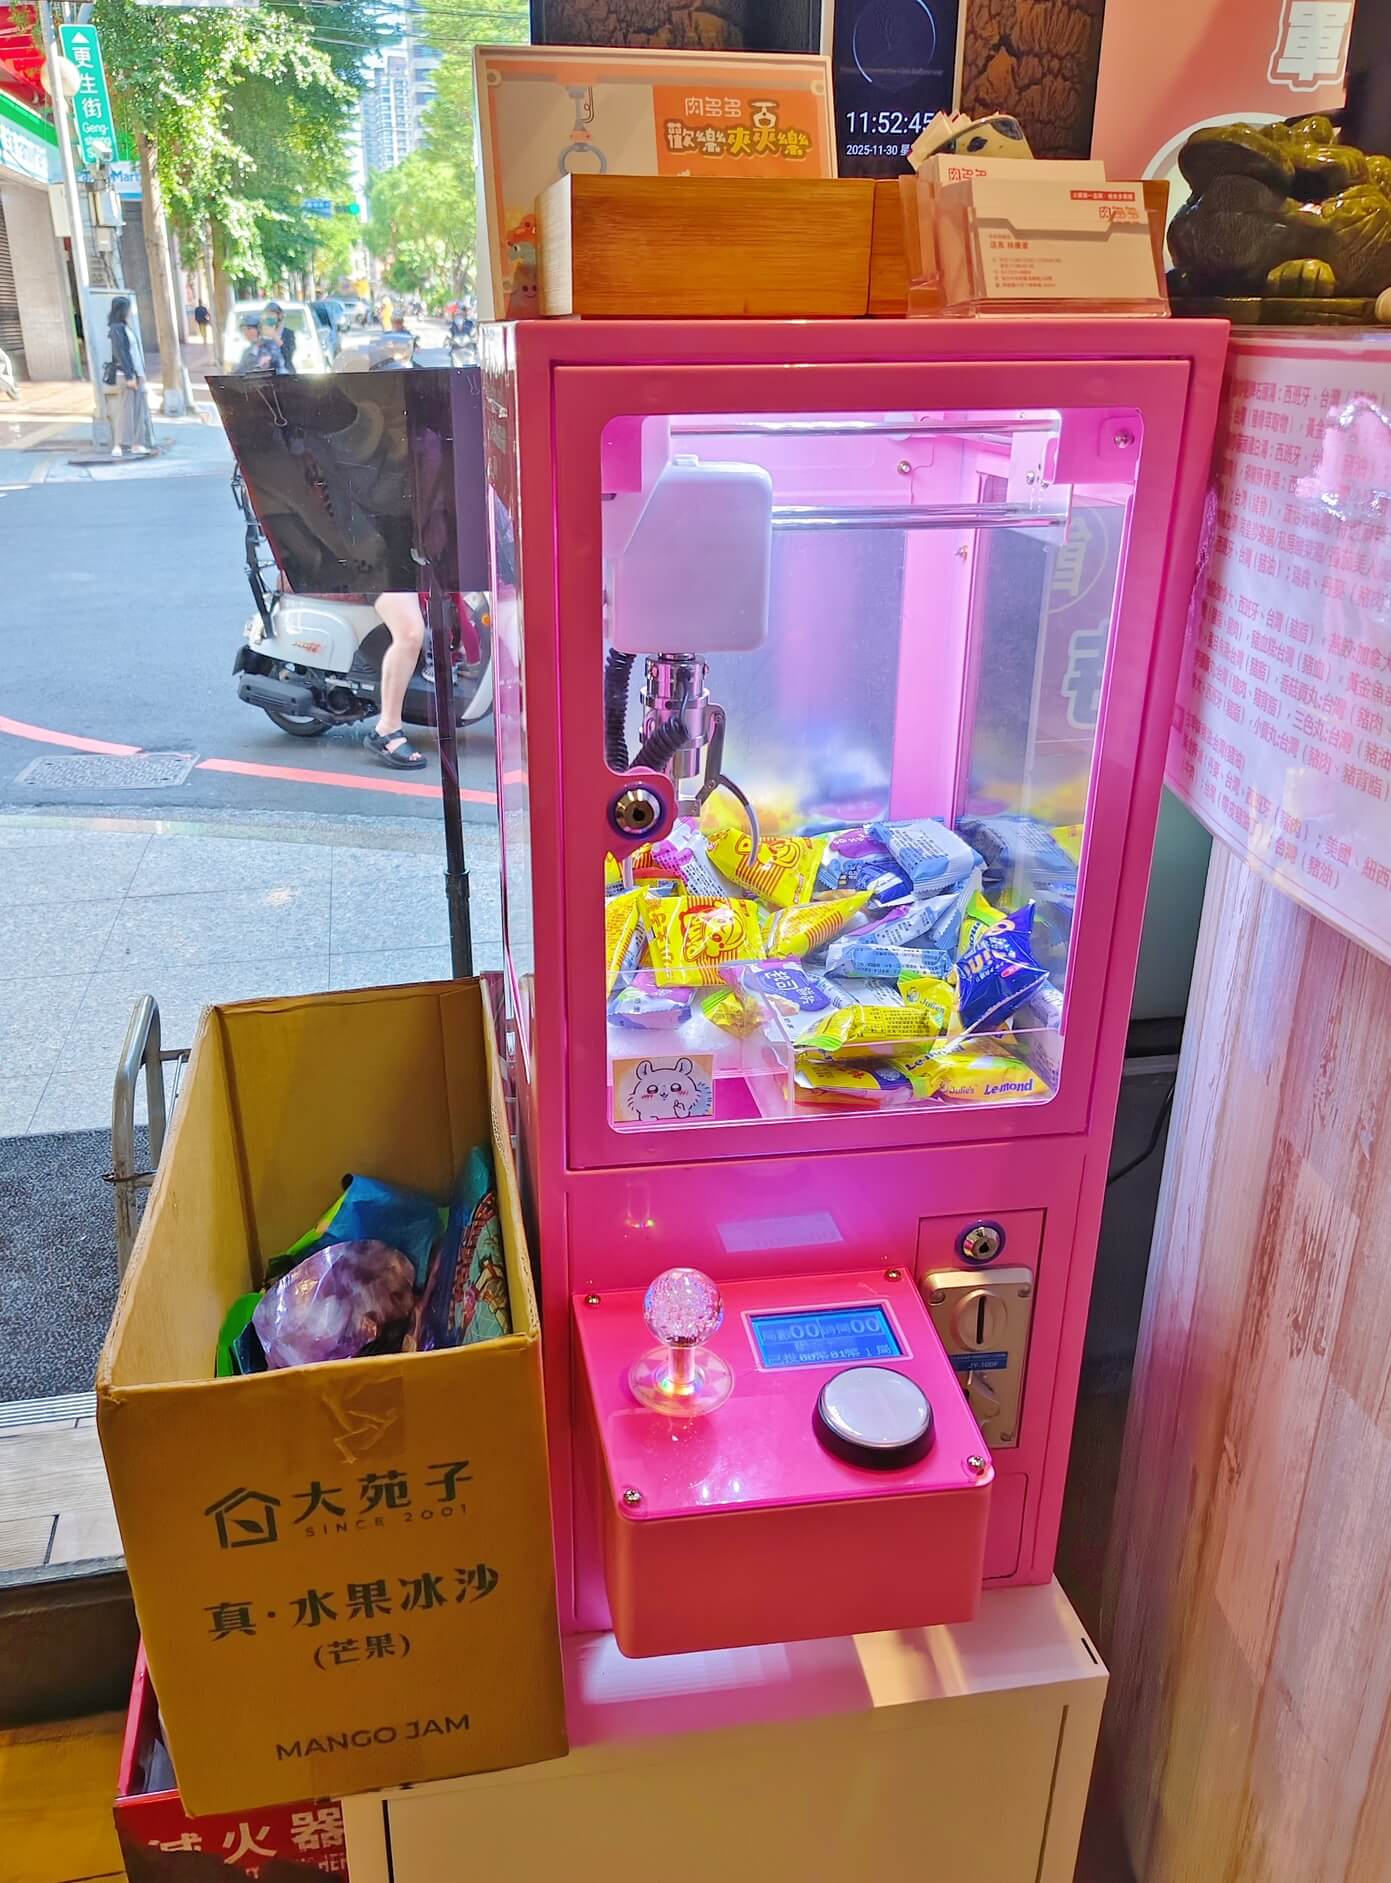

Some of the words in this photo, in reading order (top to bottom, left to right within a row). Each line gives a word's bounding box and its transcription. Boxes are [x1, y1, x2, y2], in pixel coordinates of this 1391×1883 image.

[71, 47, 102, 119] 更生街
[685, 96, 742, 118] 肉多多
[846, 144, 898, 155] 2025-11-30
[292, 1460, 473, 1524] 大苑子
[304, 1515, 385, 1537] SINCE
[403, 1503, 467, 1523] 2001
[312, 1632, 411, 1671] (芒果)
[275, 1726, 398, 1761] MANGO
[404, 1713, 471, 1740] JAM
